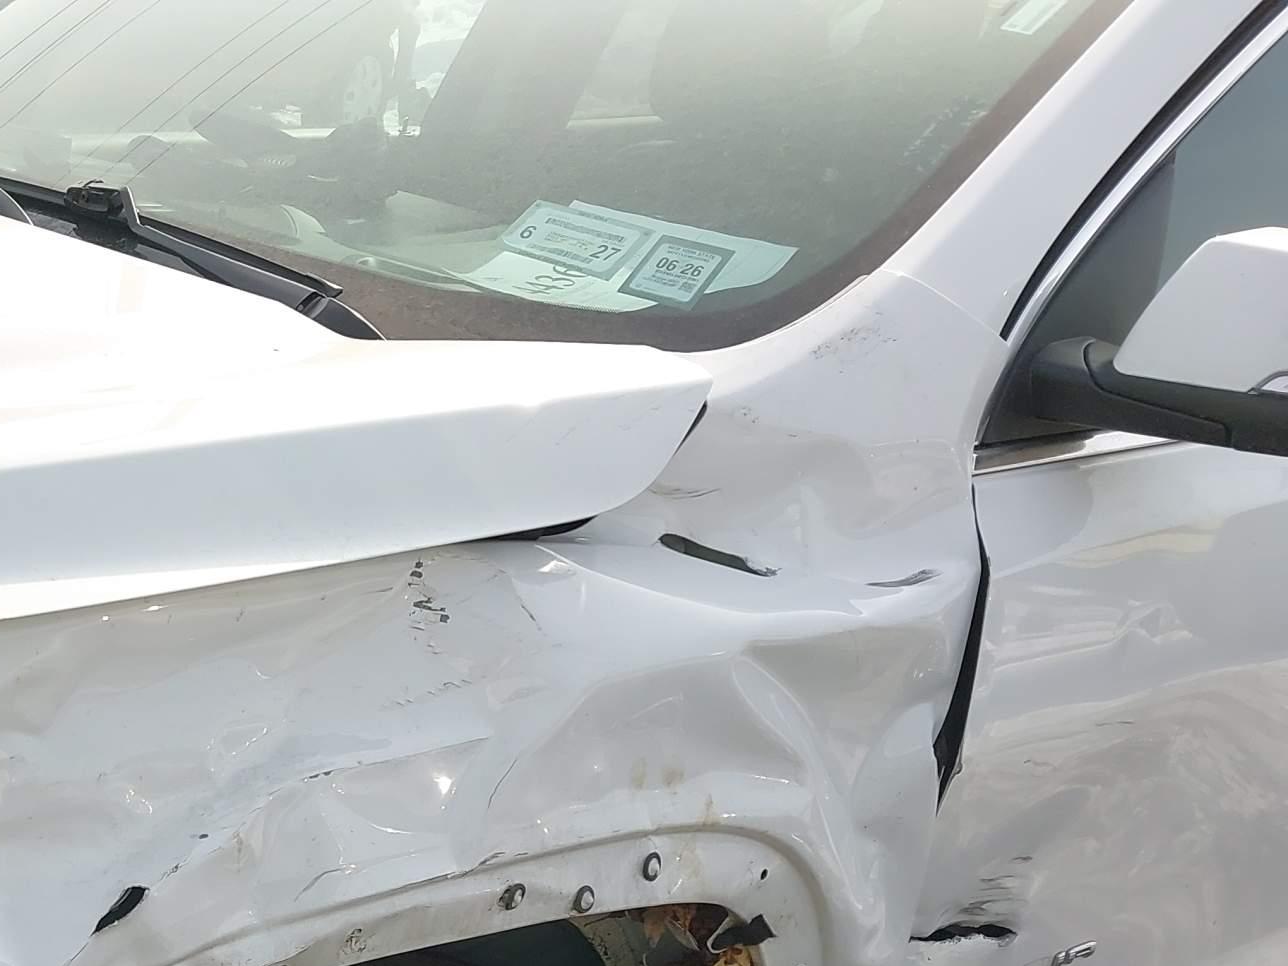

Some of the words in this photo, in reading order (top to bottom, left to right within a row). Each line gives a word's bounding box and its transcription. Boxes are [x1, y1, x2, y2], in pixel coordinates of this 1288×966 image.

[519, 225, 537, 239] 6
[588, 243, 622, 262] 27
[655, 256, 681, 272] 06
[679, 262, 705, 278] 26
